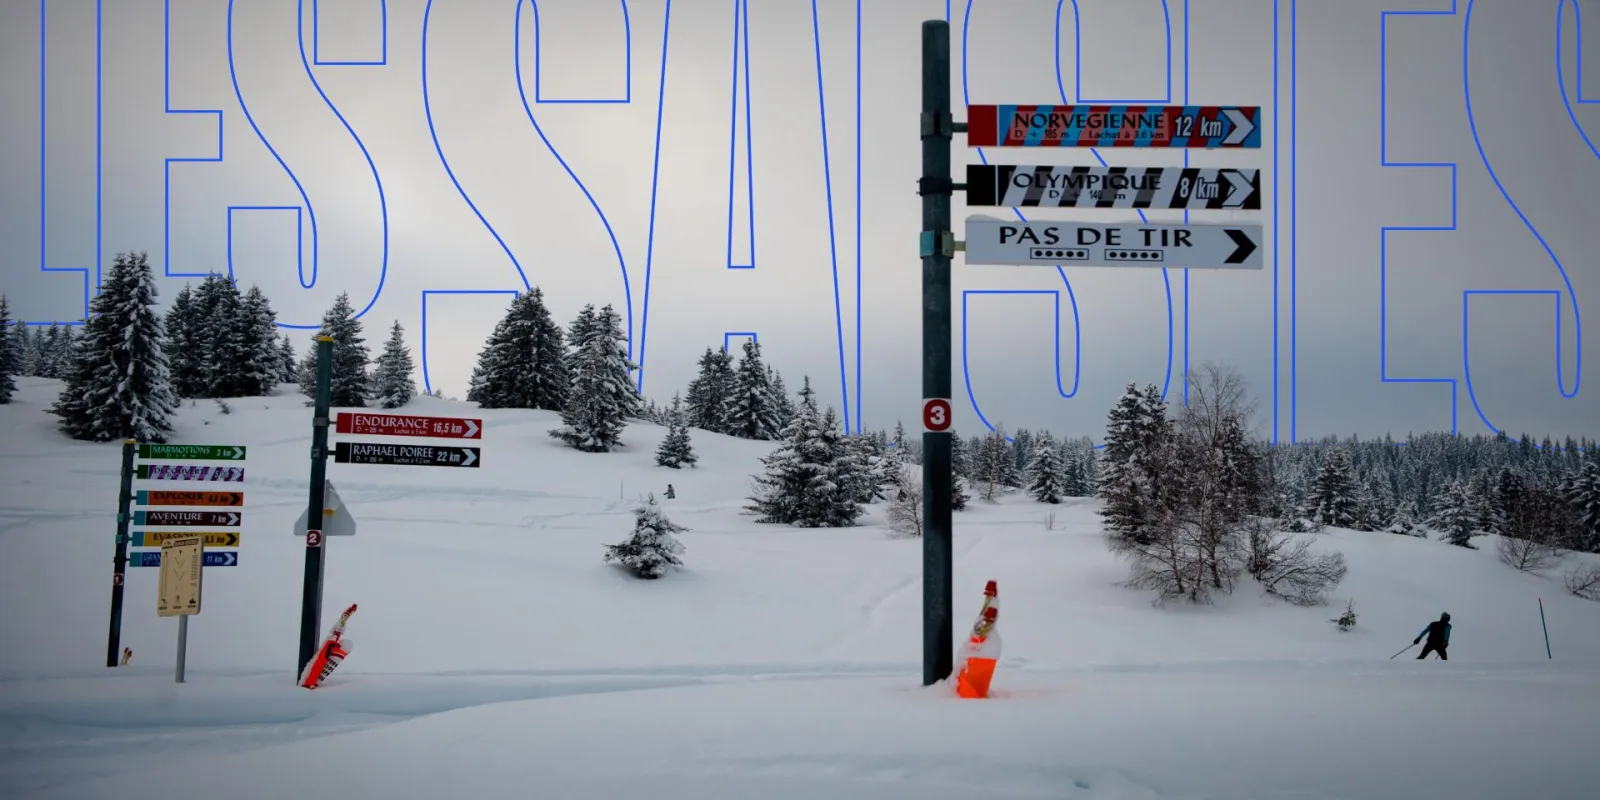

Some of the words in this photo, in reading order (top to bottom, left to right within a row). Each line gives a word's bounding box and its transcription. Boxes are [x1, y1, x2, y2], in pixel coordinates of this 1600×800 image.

[1014, 113, 1164, 129] NORVEGIENNE
[1174, 115, 1193, 137] 12
[1200, 116, 1222, 137] km
[1088, 130, 1120, 139] Lachat
[1124, 130, 1130, 139] à
[1150, 130, 1164, 139] km
[1013, 173, 1161, 190] OLYMPIQUE
[1180, 180, 1189, 199] 8
[1198, 178, 1219, 199] km
[999, 226, 1060, 245] PAS
[1077, 228, 1121, 246] DE
[1139, 229, 1193, 247] TIR
[930, 405, 946, 425] 3
[355, 416, 429, 429] ENDURANCE
[433, 422, 449, 435] 16,5
[450, 423, 462, 434] km
[152, 446, 210, 455] MARMOTTONS
[353, 445, 398, 456] RAPHAEL
[400, 447, 434, 458] POIREE
[437, 451, 447, 462] 22
[450, 453, 461, 462] km
[150, 512, 202, 521] AVENTURE
[211, 515, 216, 523] 7
[218, 515, 227, 523] km
[309, 533, 317, 543] 2
[215, 555, 223, 563] km
